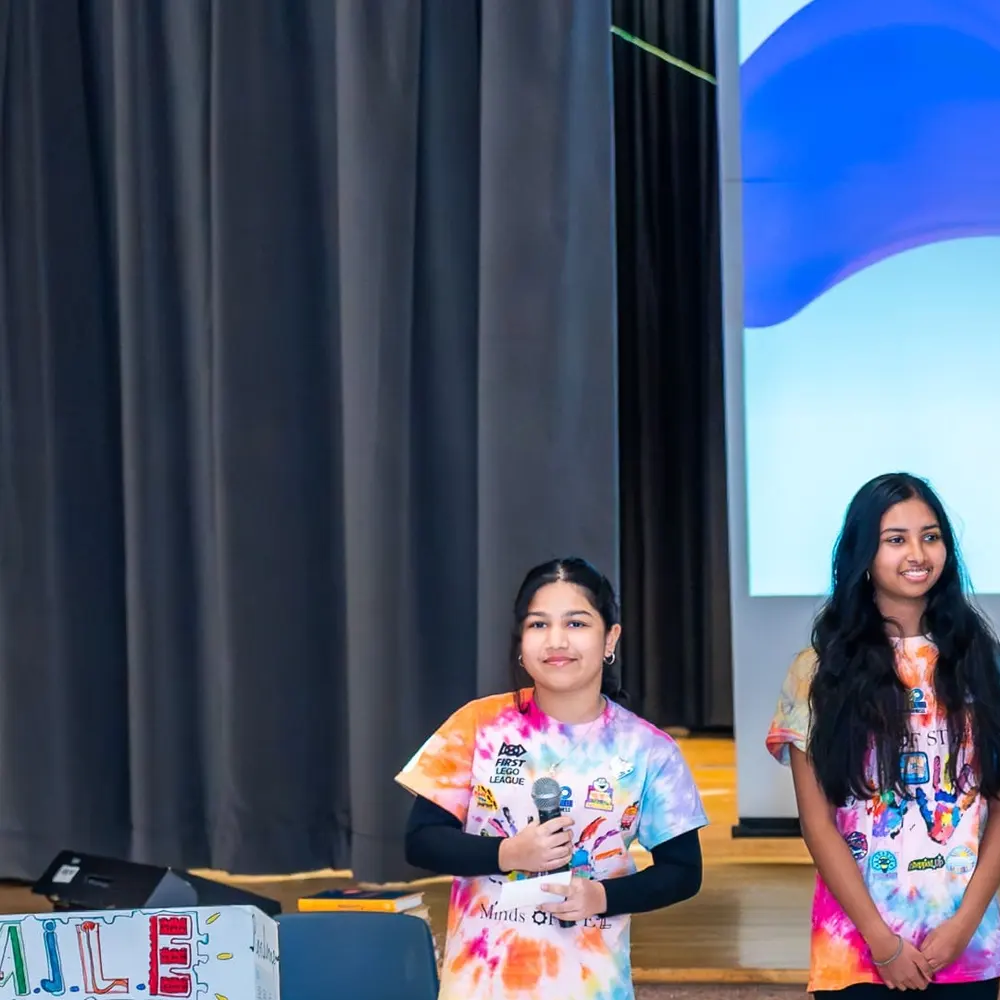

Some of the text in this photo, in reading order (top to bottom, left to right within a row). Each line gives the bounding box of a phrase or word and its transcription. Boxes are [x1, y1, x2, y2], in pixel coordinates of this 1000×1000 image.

[496, 758, 526, 767] FIRST
[496, 767, 519, 775] LEGO
[489, 776, 525, 785] LEAGUE
[480, 900, 526, 923] Minds
